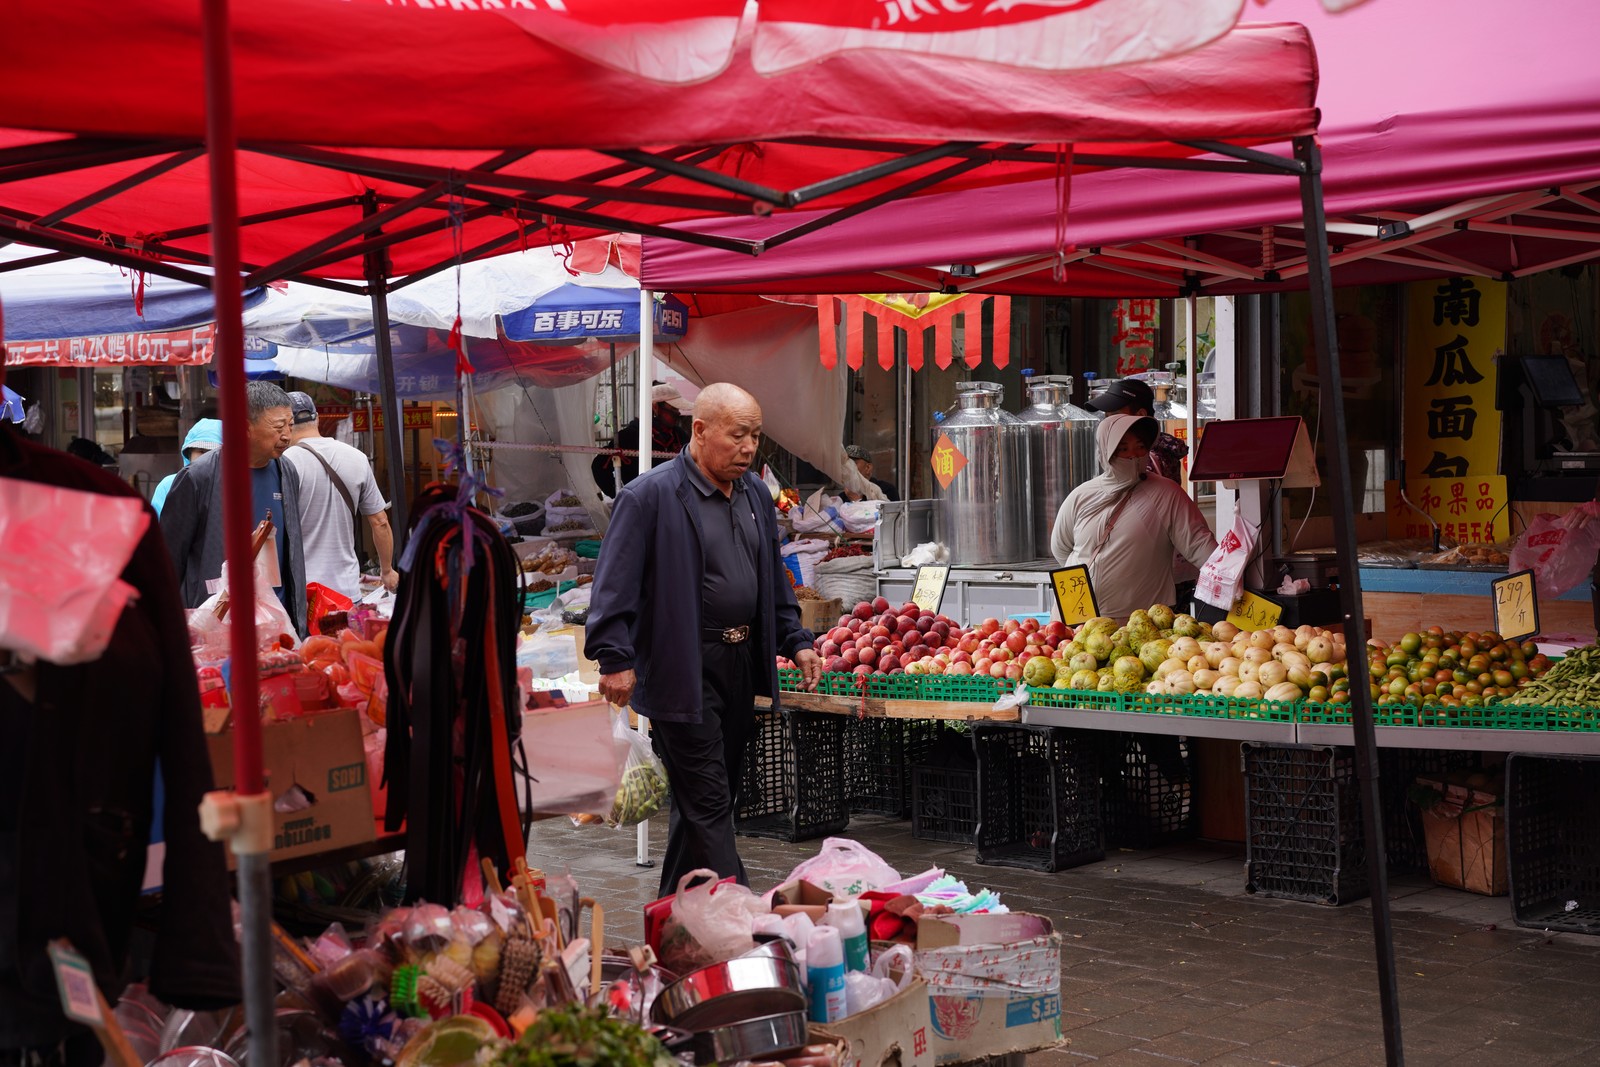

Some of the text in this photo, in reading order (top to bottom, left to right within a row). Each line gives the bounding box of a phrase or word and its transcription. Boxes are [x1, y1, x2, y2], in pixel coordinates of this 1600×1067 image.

[533, 309, 623, 333] 百事可乐
[5, 340, 60, 365] 元一只
[935, 446, 953, 477] 酒
